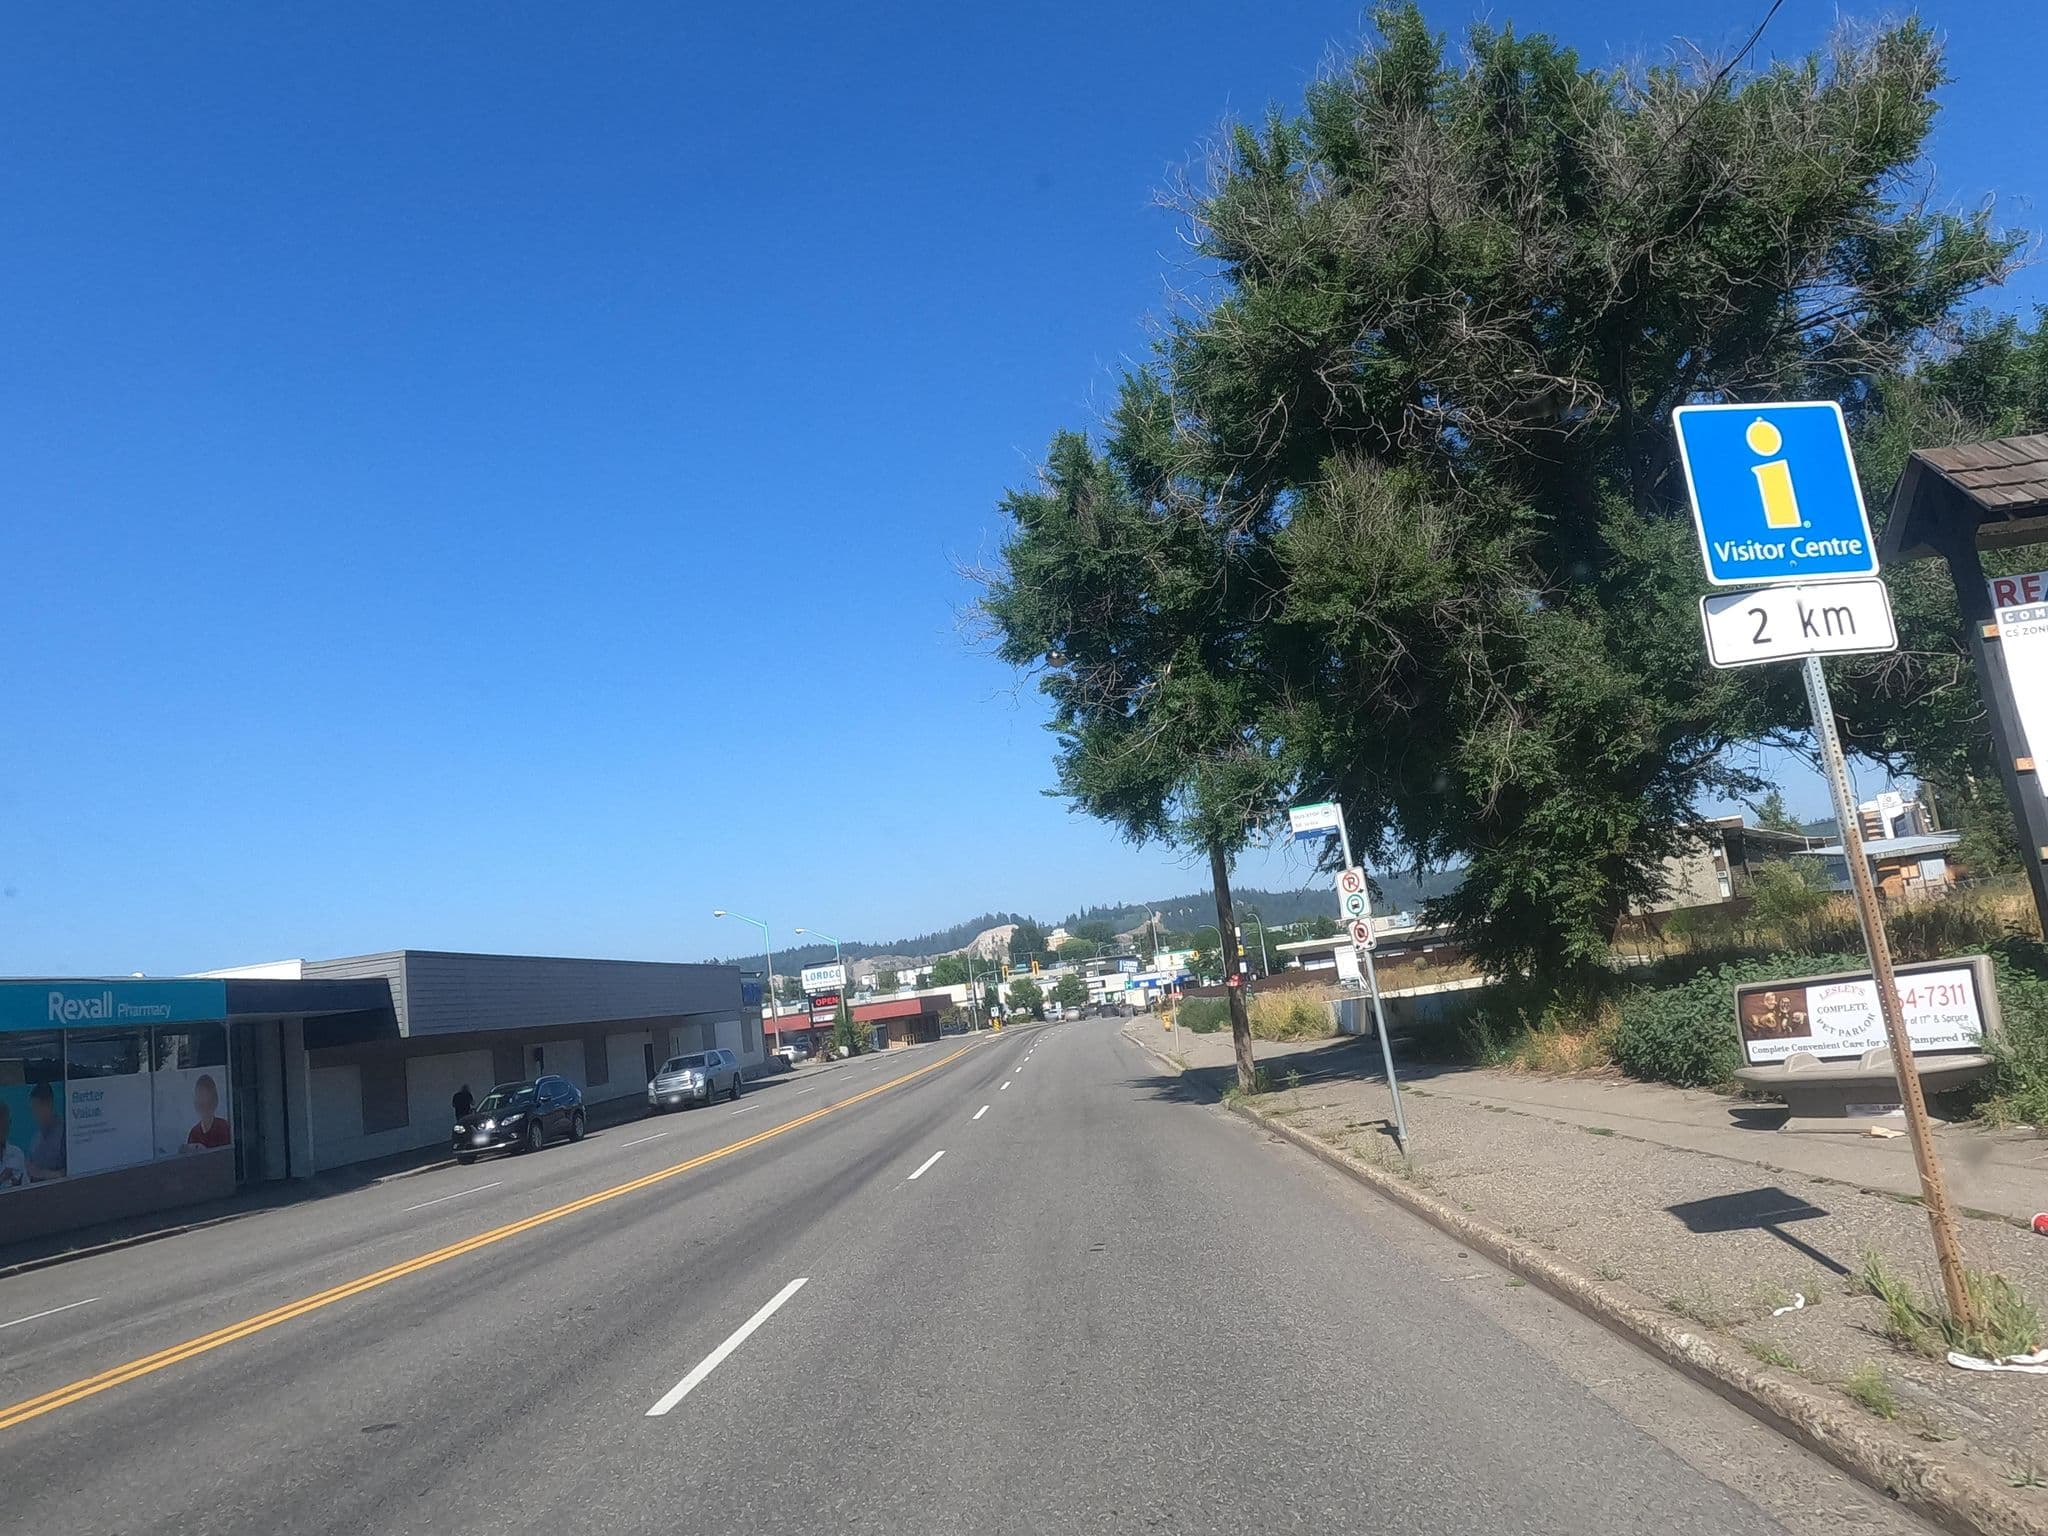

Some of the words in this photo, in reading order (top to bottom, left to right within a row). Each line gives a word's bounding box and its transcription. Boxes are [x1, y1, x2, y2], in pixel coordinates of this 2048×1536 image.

[1714, 539, 1785, 562] Visitor
[1791, 537, 1863, 558] Centre
[1993, 575, 2048, 607] RE
[1748, 608, 1772, 644] 2
[1797, 600, 1856, 638] km
[2022, 624, 2048, 635] ZON
[805, 969, 840, 982] LORDCO
[1819, 984, 1865, 1000] LESLEY'S
[48, 991, 113, 1024] Rexall
[117, 1003, 172, 1018] Pharmacy
[815, 996, 838, 1006] OPEN
[1816, 1002, 1868, 1015] COMPLETE
[1816, 1017, 1836, 1034] PET
[1838, 1013, 1876, 1037] PARLOR
[1942, 1014, 1969, 1024] Spruce
[1752, 1045, 1790, 1055] Complete
[1791, 1041, 1841, 1052] Convenient
[1843, 1039, 1865, 1049] Care
[1866, 1038, 1880, 1047] for
